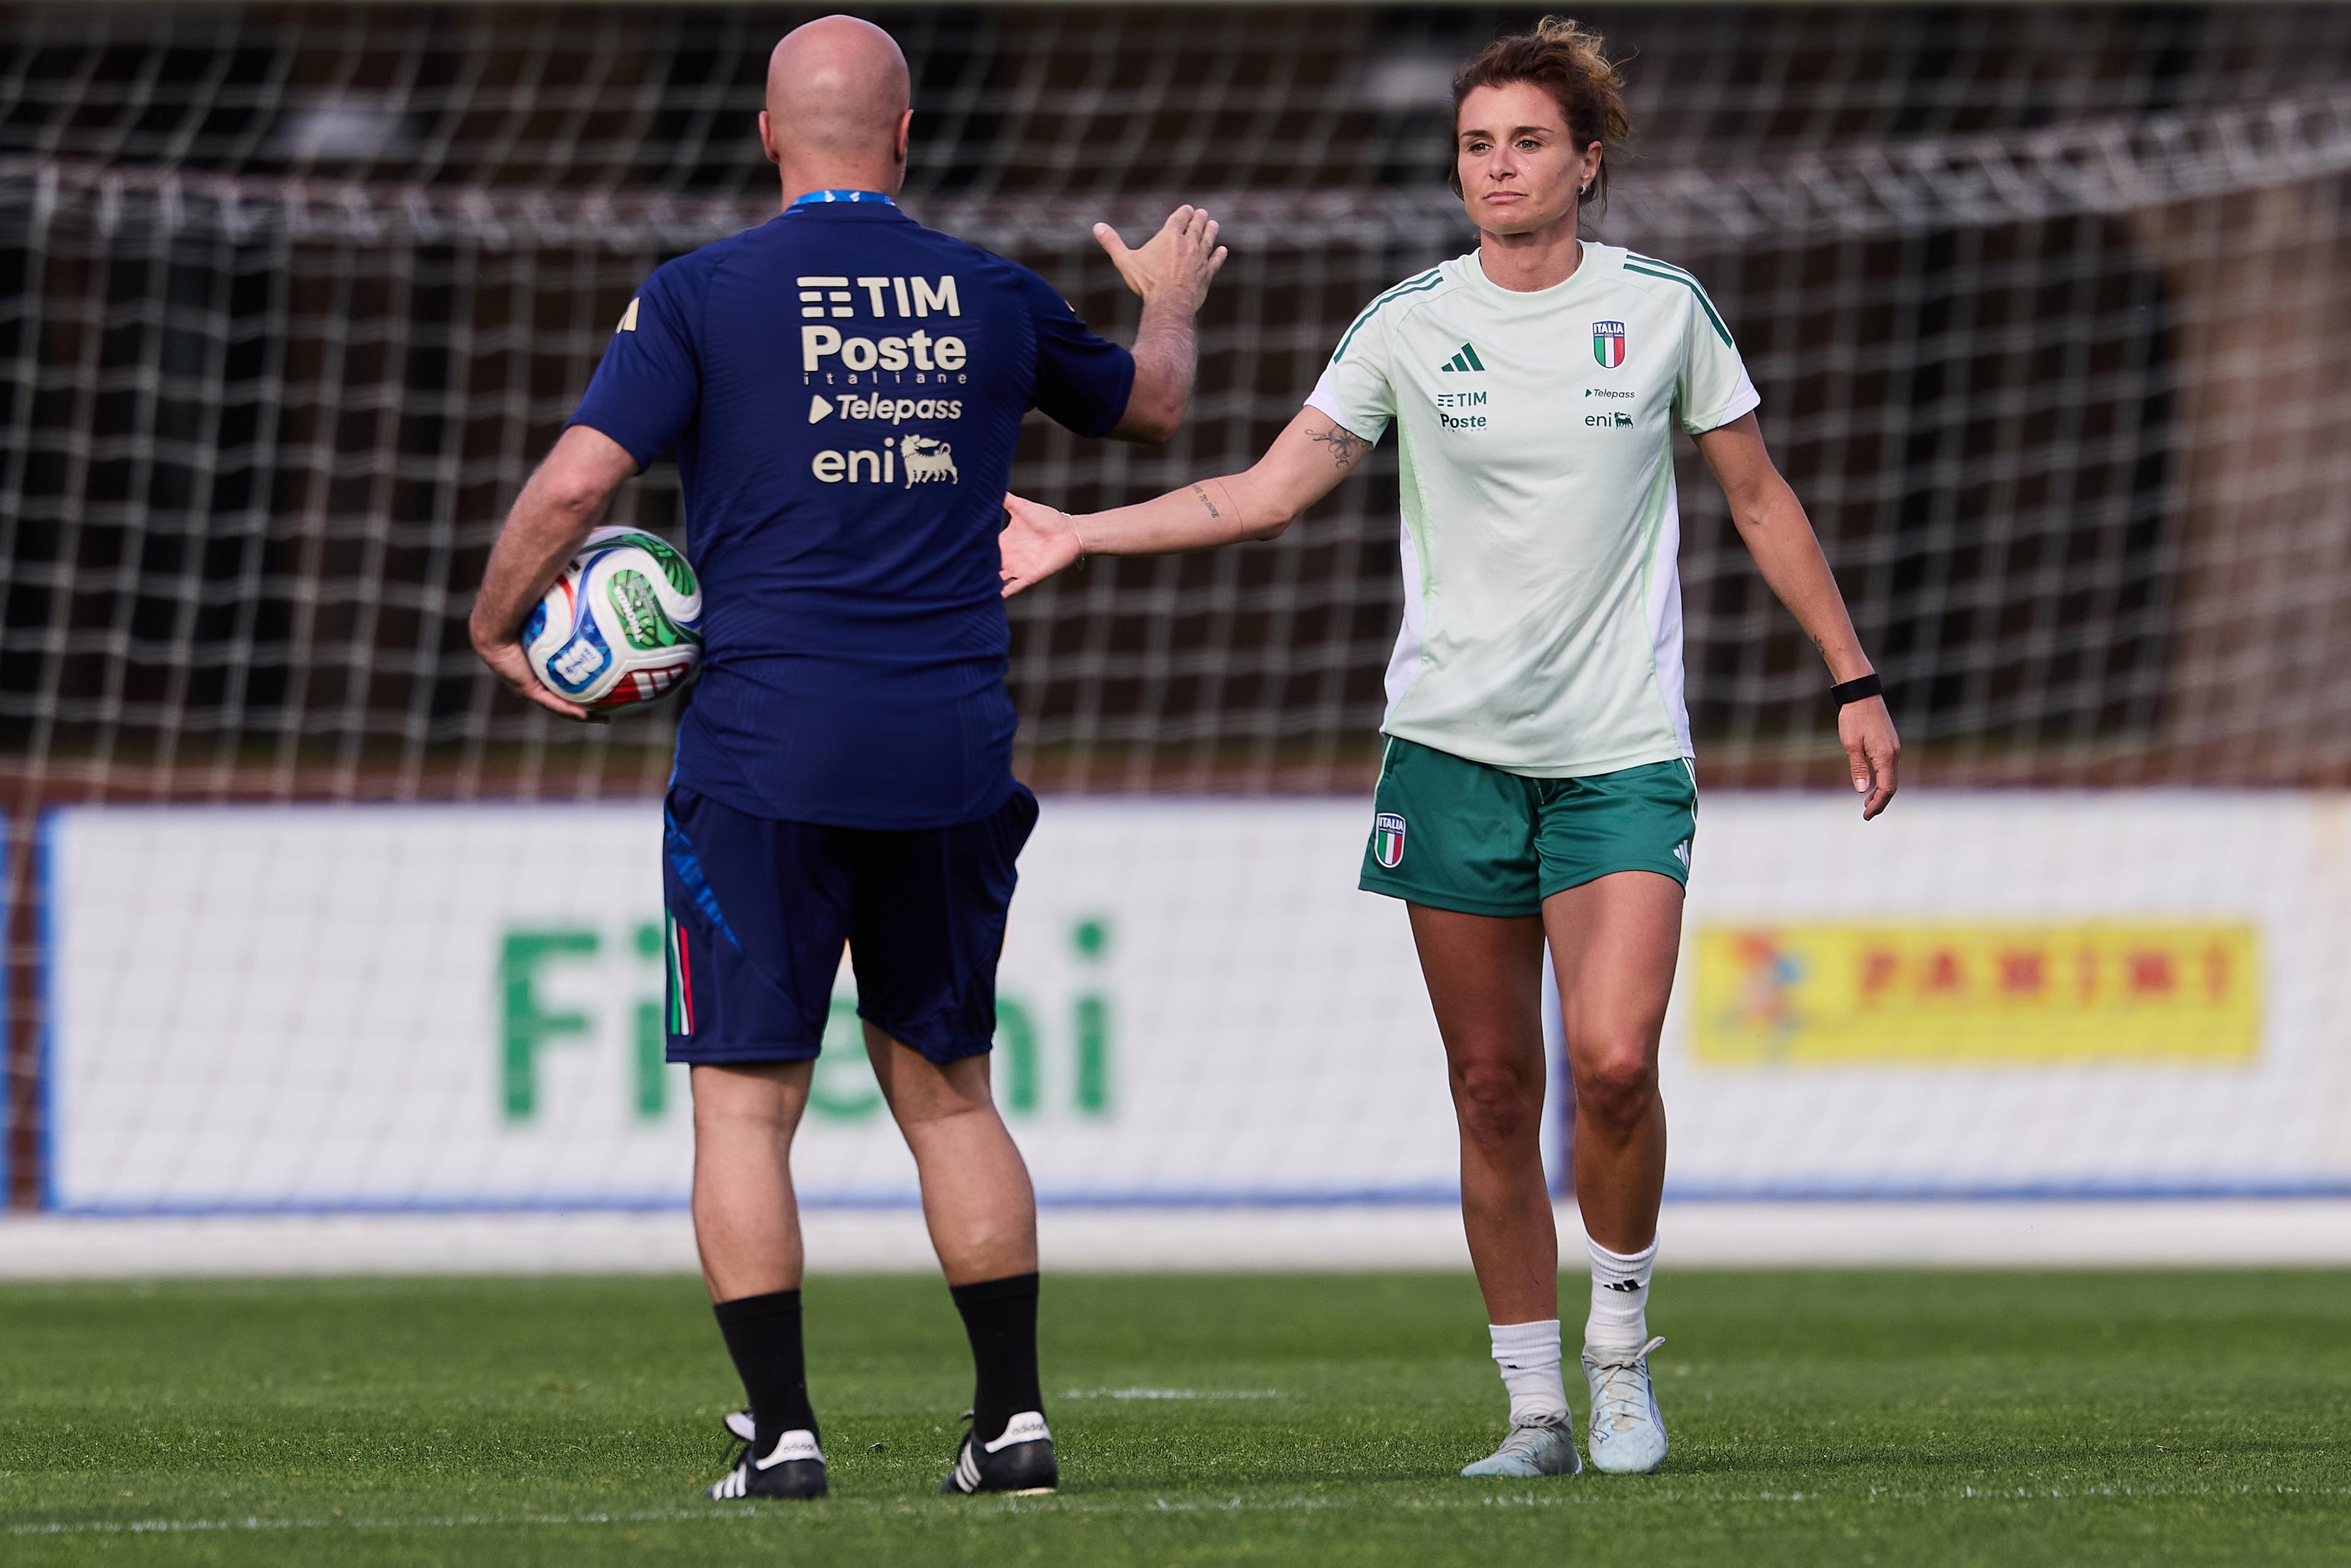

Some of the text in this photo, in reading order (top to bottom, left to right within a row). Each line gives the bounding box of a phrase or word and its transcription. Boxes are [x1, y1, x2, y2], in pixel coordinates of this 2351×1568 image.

[857, 275, 961, 318] TIM
[1594, 323, 1624, 334] ITALIA
[801, 325, 967, 372] Poste
[803, 371, 968, 385] italiane
[1457, 391, 1487, 407] TIM
[1594, 388, 1635, 400] Telepass
[836, 391, 963, 426] Telepass
[1440, 413, 1487, 429] Poste
[1584, 411, 1612, 427] eni
[811, 437, 895, 484] eni
[1379, 817, 1404, 831] ITALIA
[1011, 1424, 1046, 1436] adida
